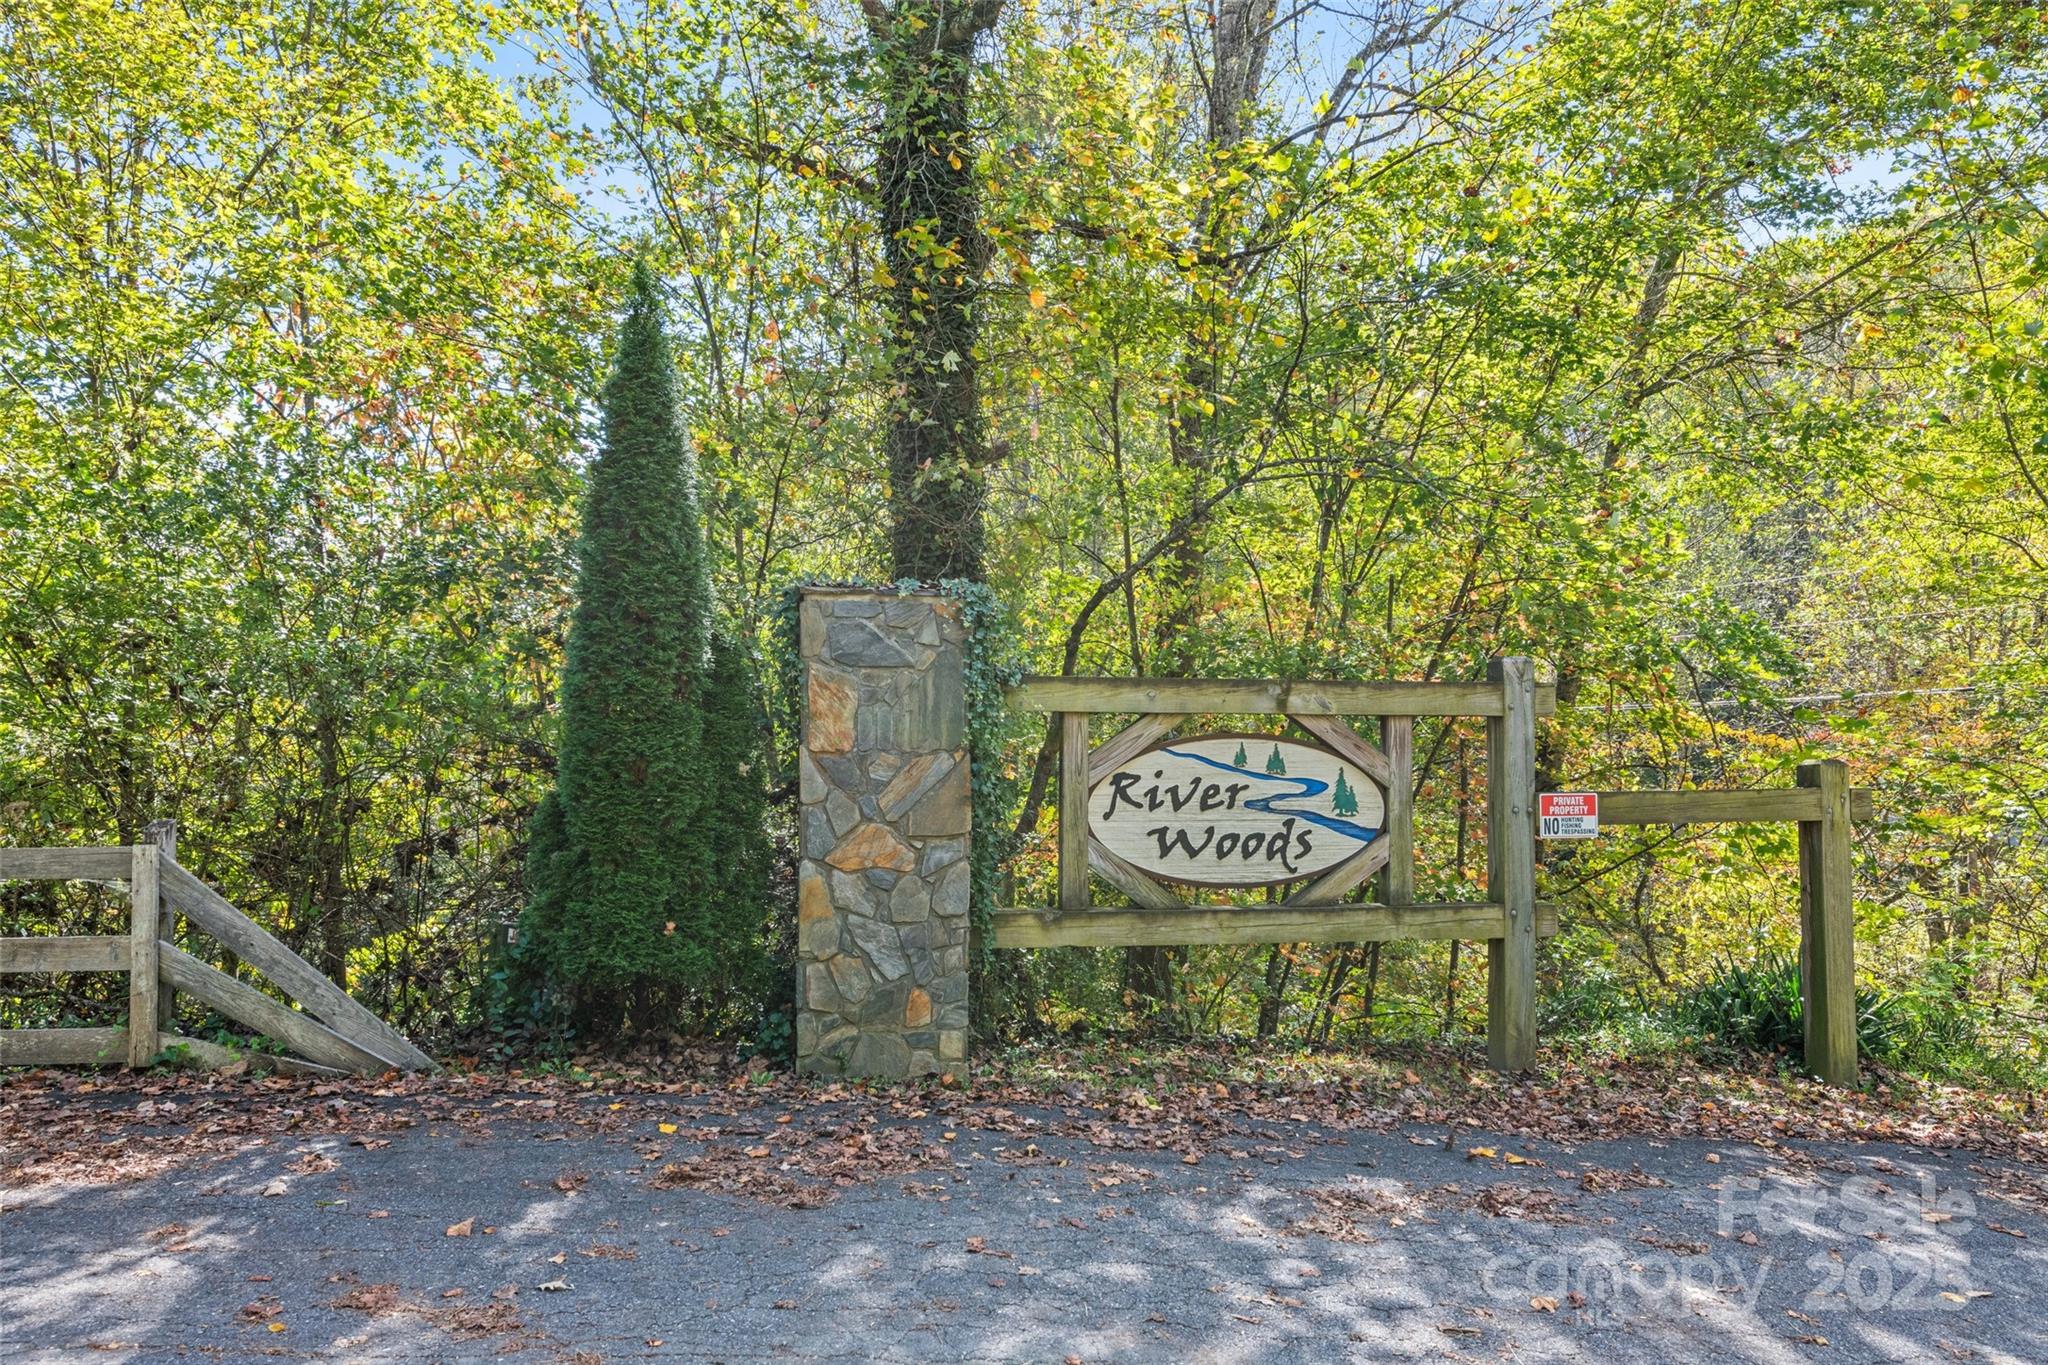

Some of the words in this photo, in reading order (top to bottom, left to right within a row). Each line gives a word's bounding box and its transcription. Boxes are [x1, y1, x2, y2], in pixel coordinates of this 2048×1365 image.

[1102, 770, 1250, 821] River
[1553, 796, 1584, 805] PRIVATE
[1549, 806, 1588, 814] PROPERTY
[1544, 818, 1559, 834] NO
[1146, 817, 1313, 874] Woods
